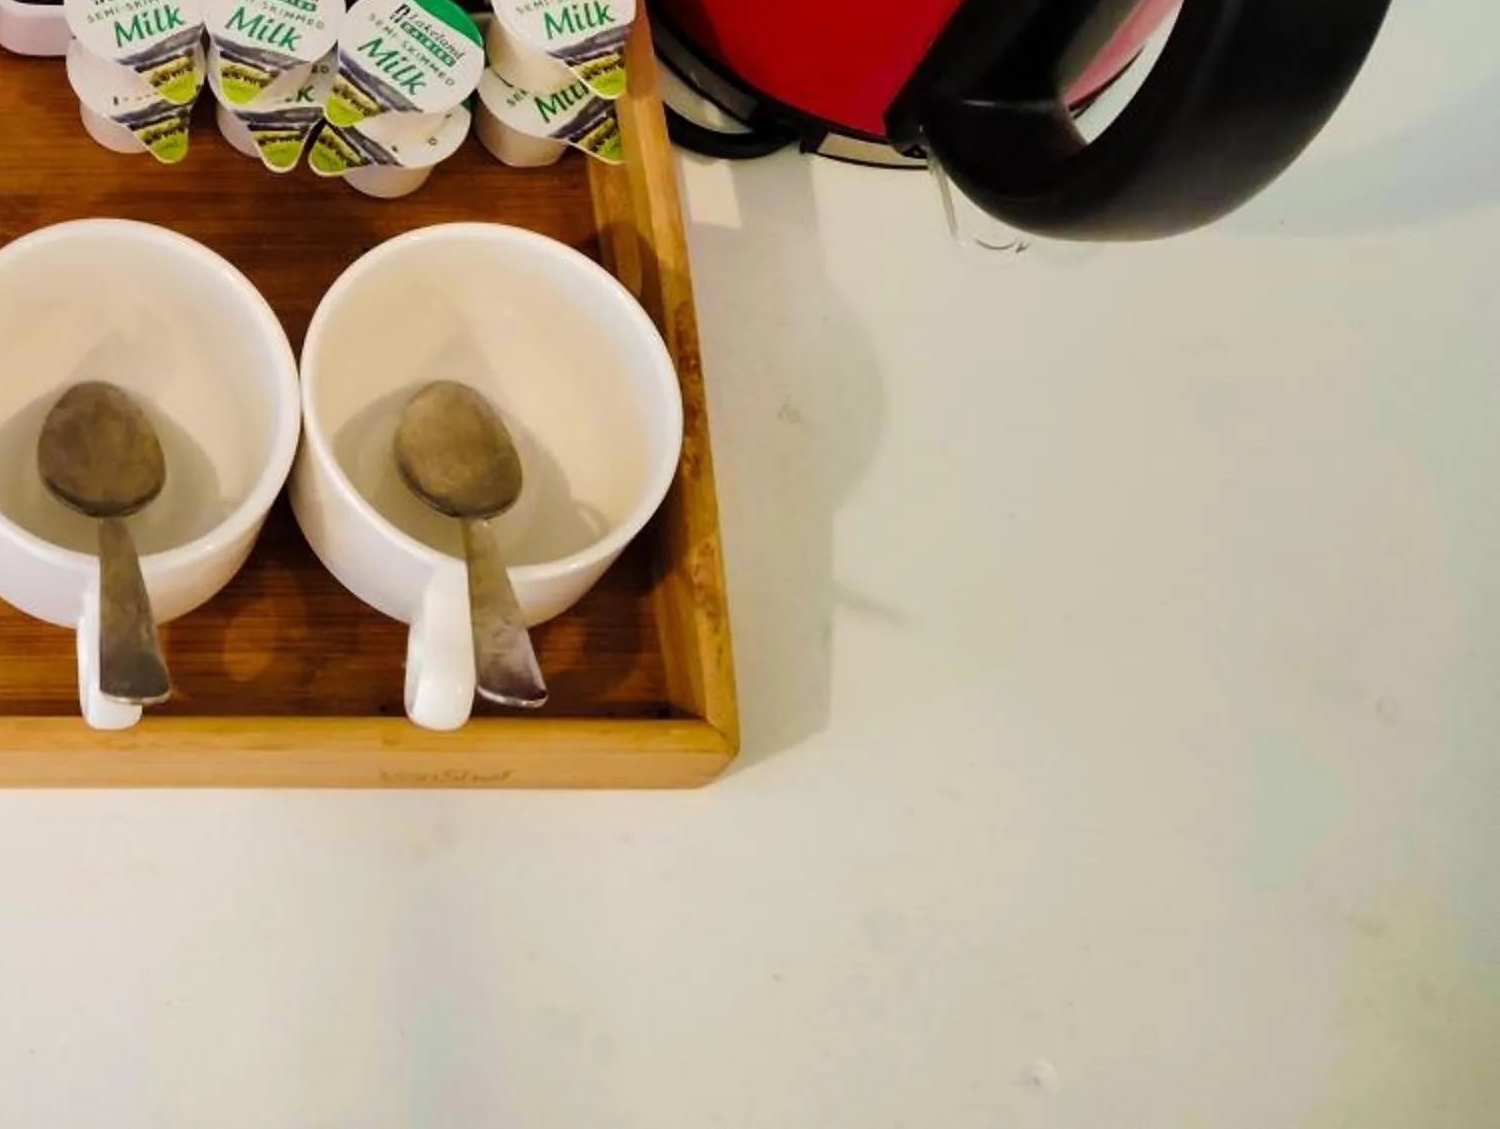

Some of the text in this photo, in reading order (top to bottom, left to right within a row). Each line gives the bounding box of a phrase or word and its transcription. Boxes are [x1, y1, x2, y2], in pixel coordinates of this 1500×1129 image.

[113, 3, 186, 48] Milk
[224, 4, 303, 52] Milk
[542, 0, 617, 41] Milk
[357, 36, 428, 96] Milk
